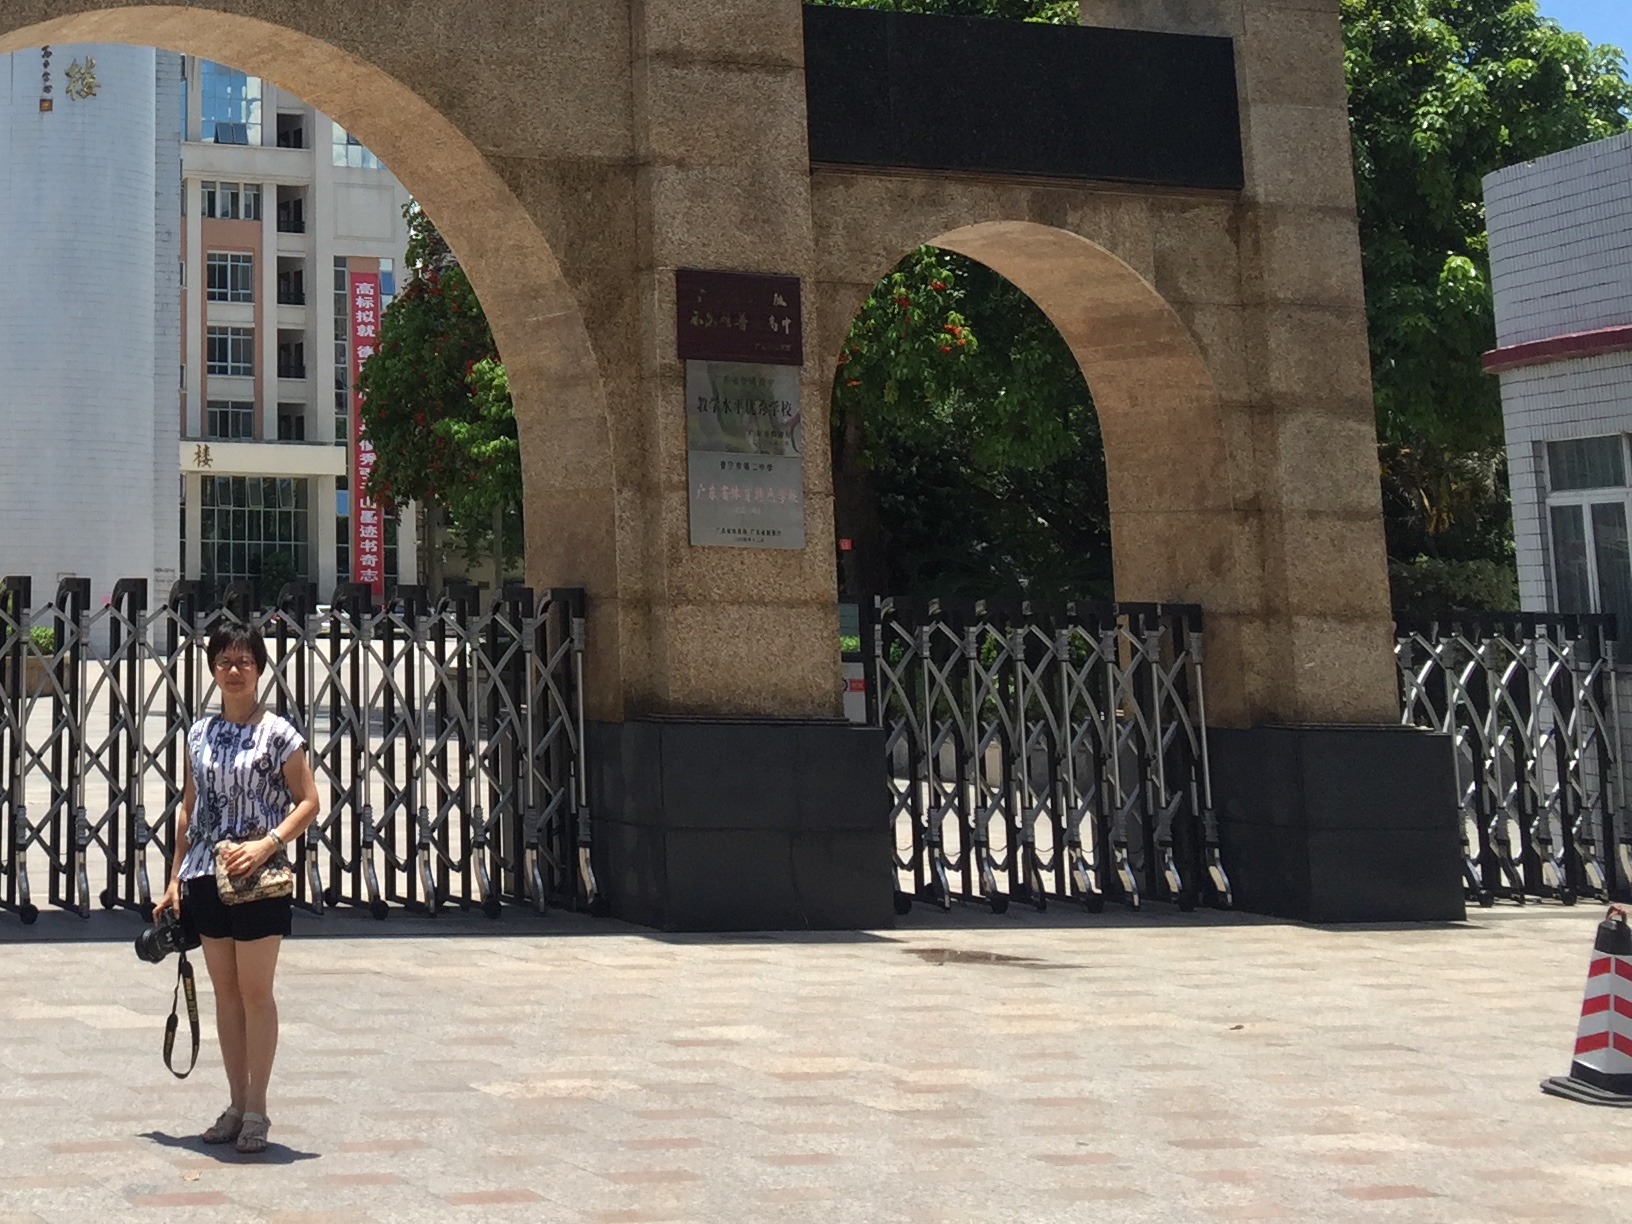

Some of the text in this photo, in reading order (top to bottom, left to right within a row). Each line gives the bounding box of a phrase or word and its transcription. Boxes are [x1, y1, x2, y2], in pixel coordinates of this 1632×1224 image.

[696, 395, 792, 417] 教学水平优秀学校
[193, 444, 214, 468] 楼
